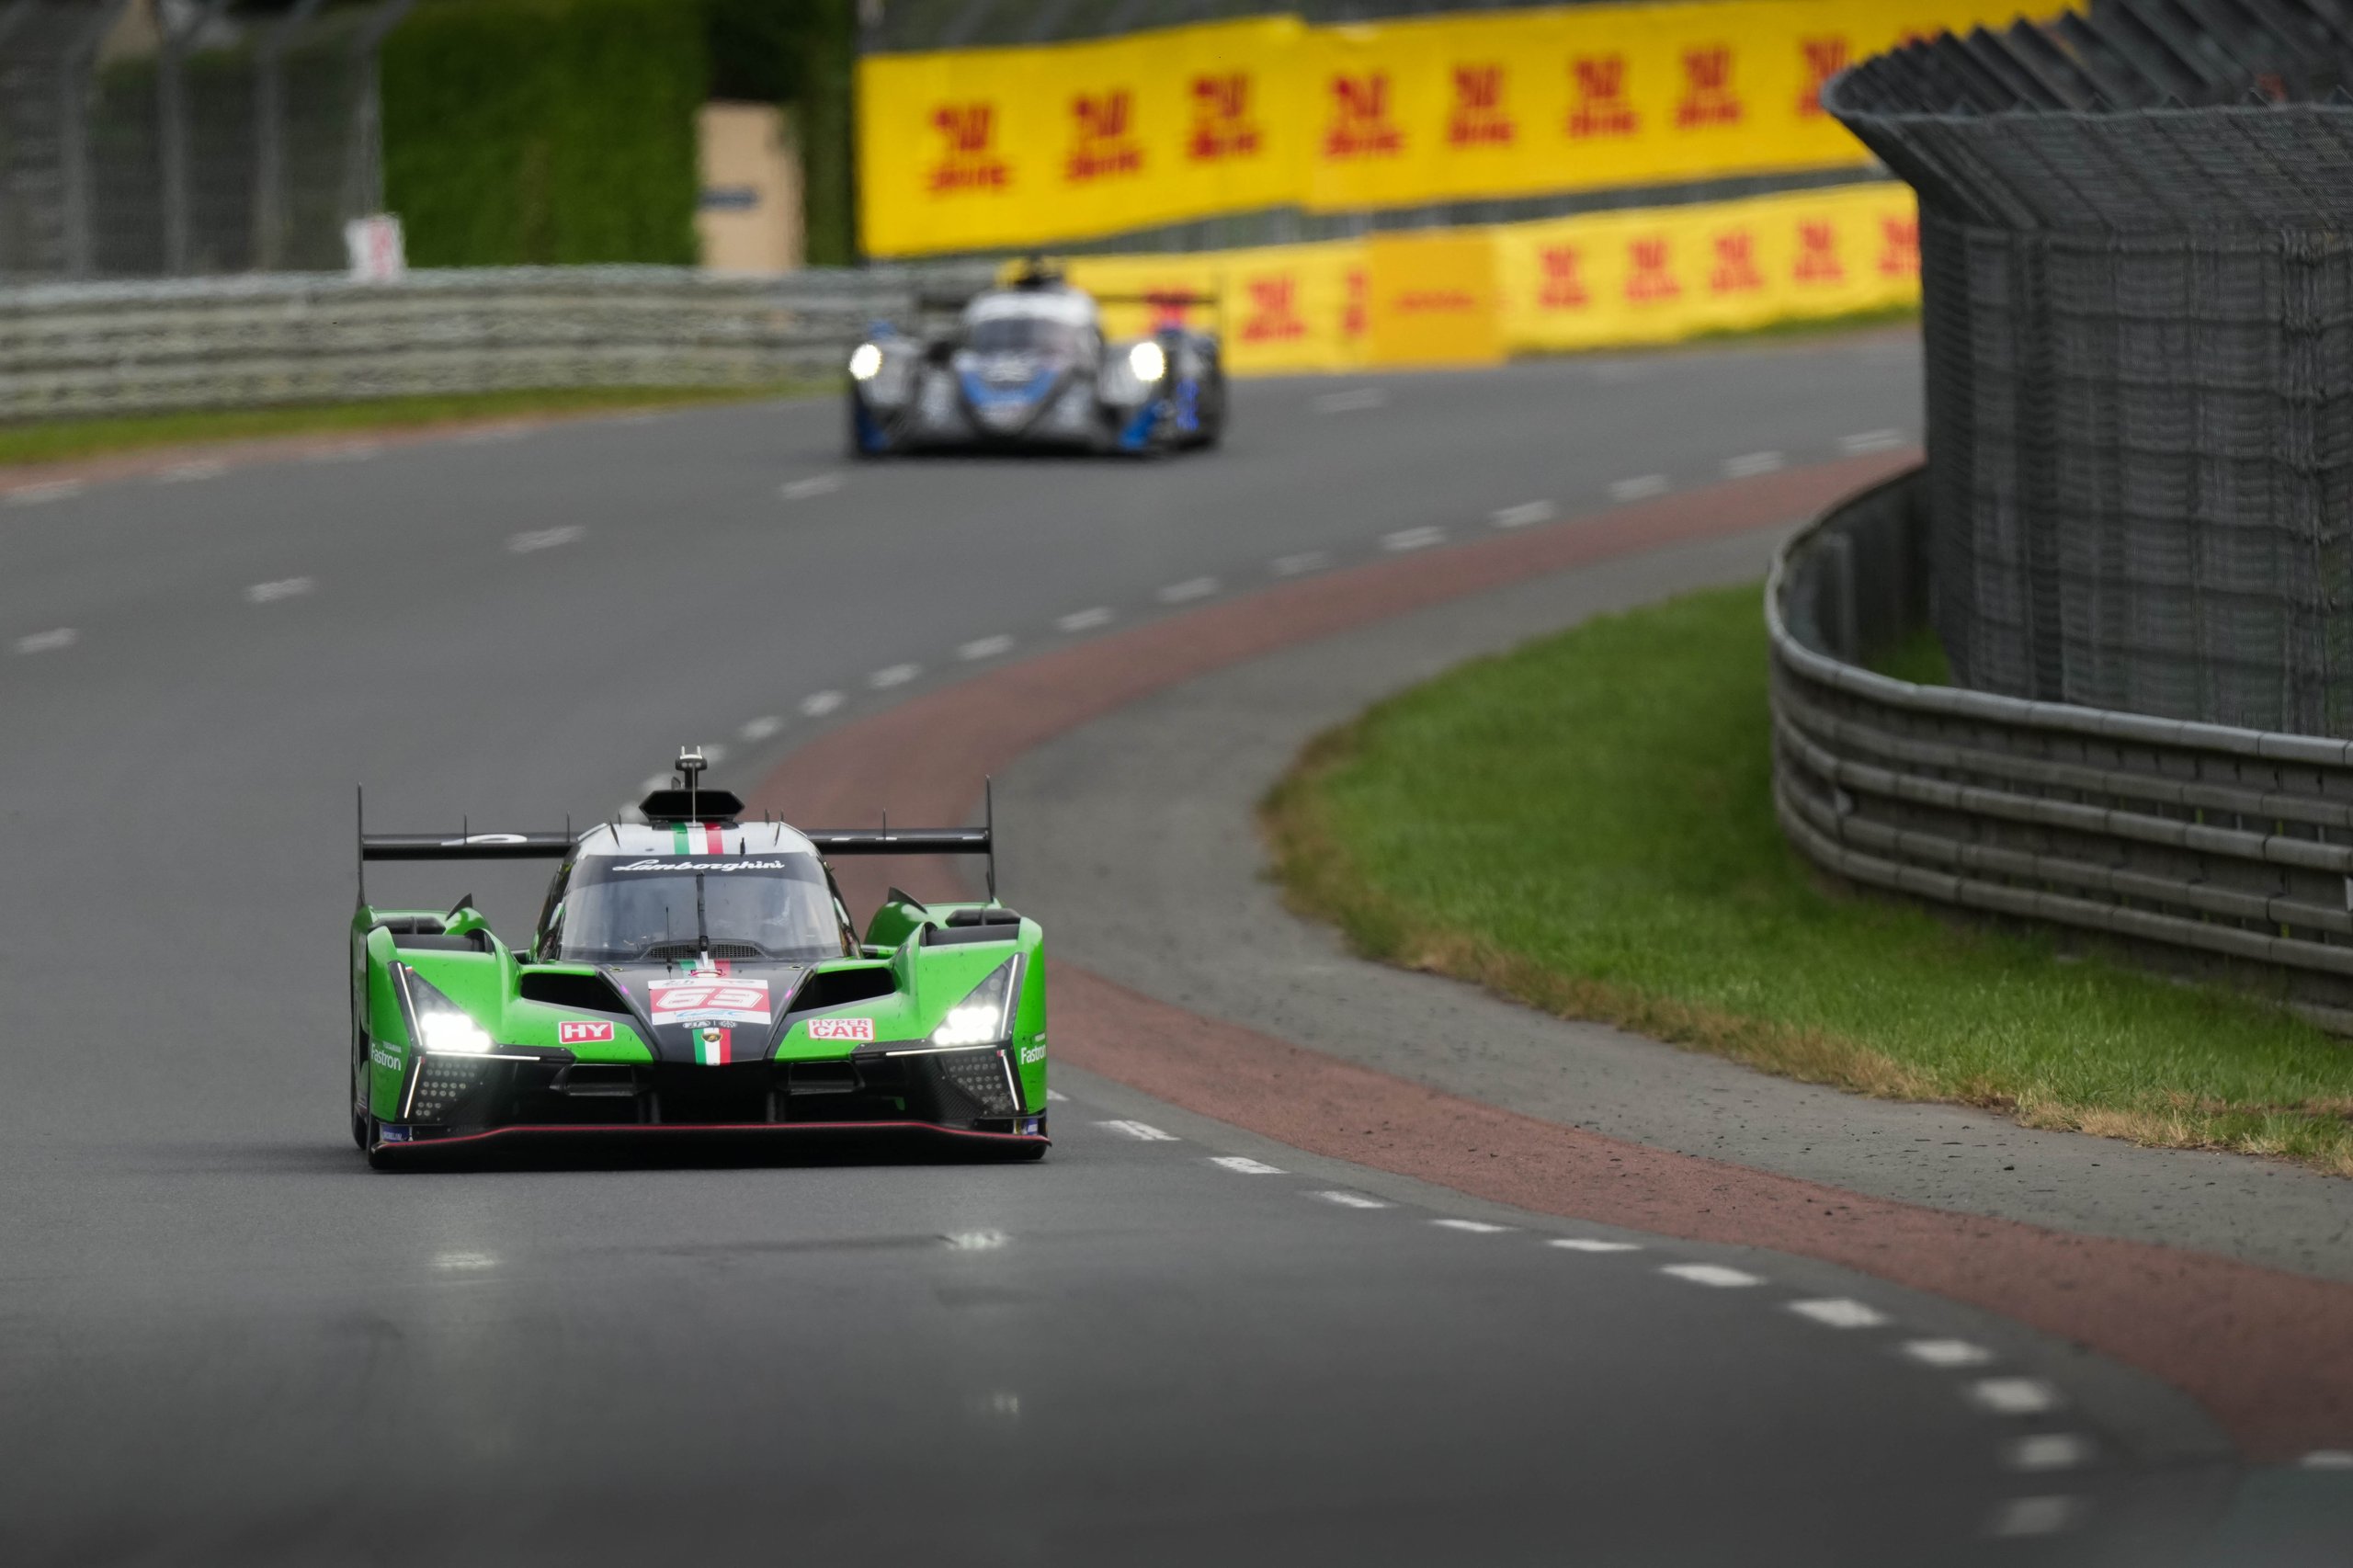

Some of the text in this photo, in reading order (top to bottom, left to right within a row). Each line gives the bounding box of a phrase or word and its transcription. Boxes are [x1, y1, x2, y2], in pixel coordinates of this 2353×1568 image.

[613, 859, 785, 871] Lamborghini
[656, 988, 764, 1008] 63
[564, 1025, 608, 1039] HY
[813, 1027, 870, 1038] CAR
[371, 1043, 402, 1071] Fastron
